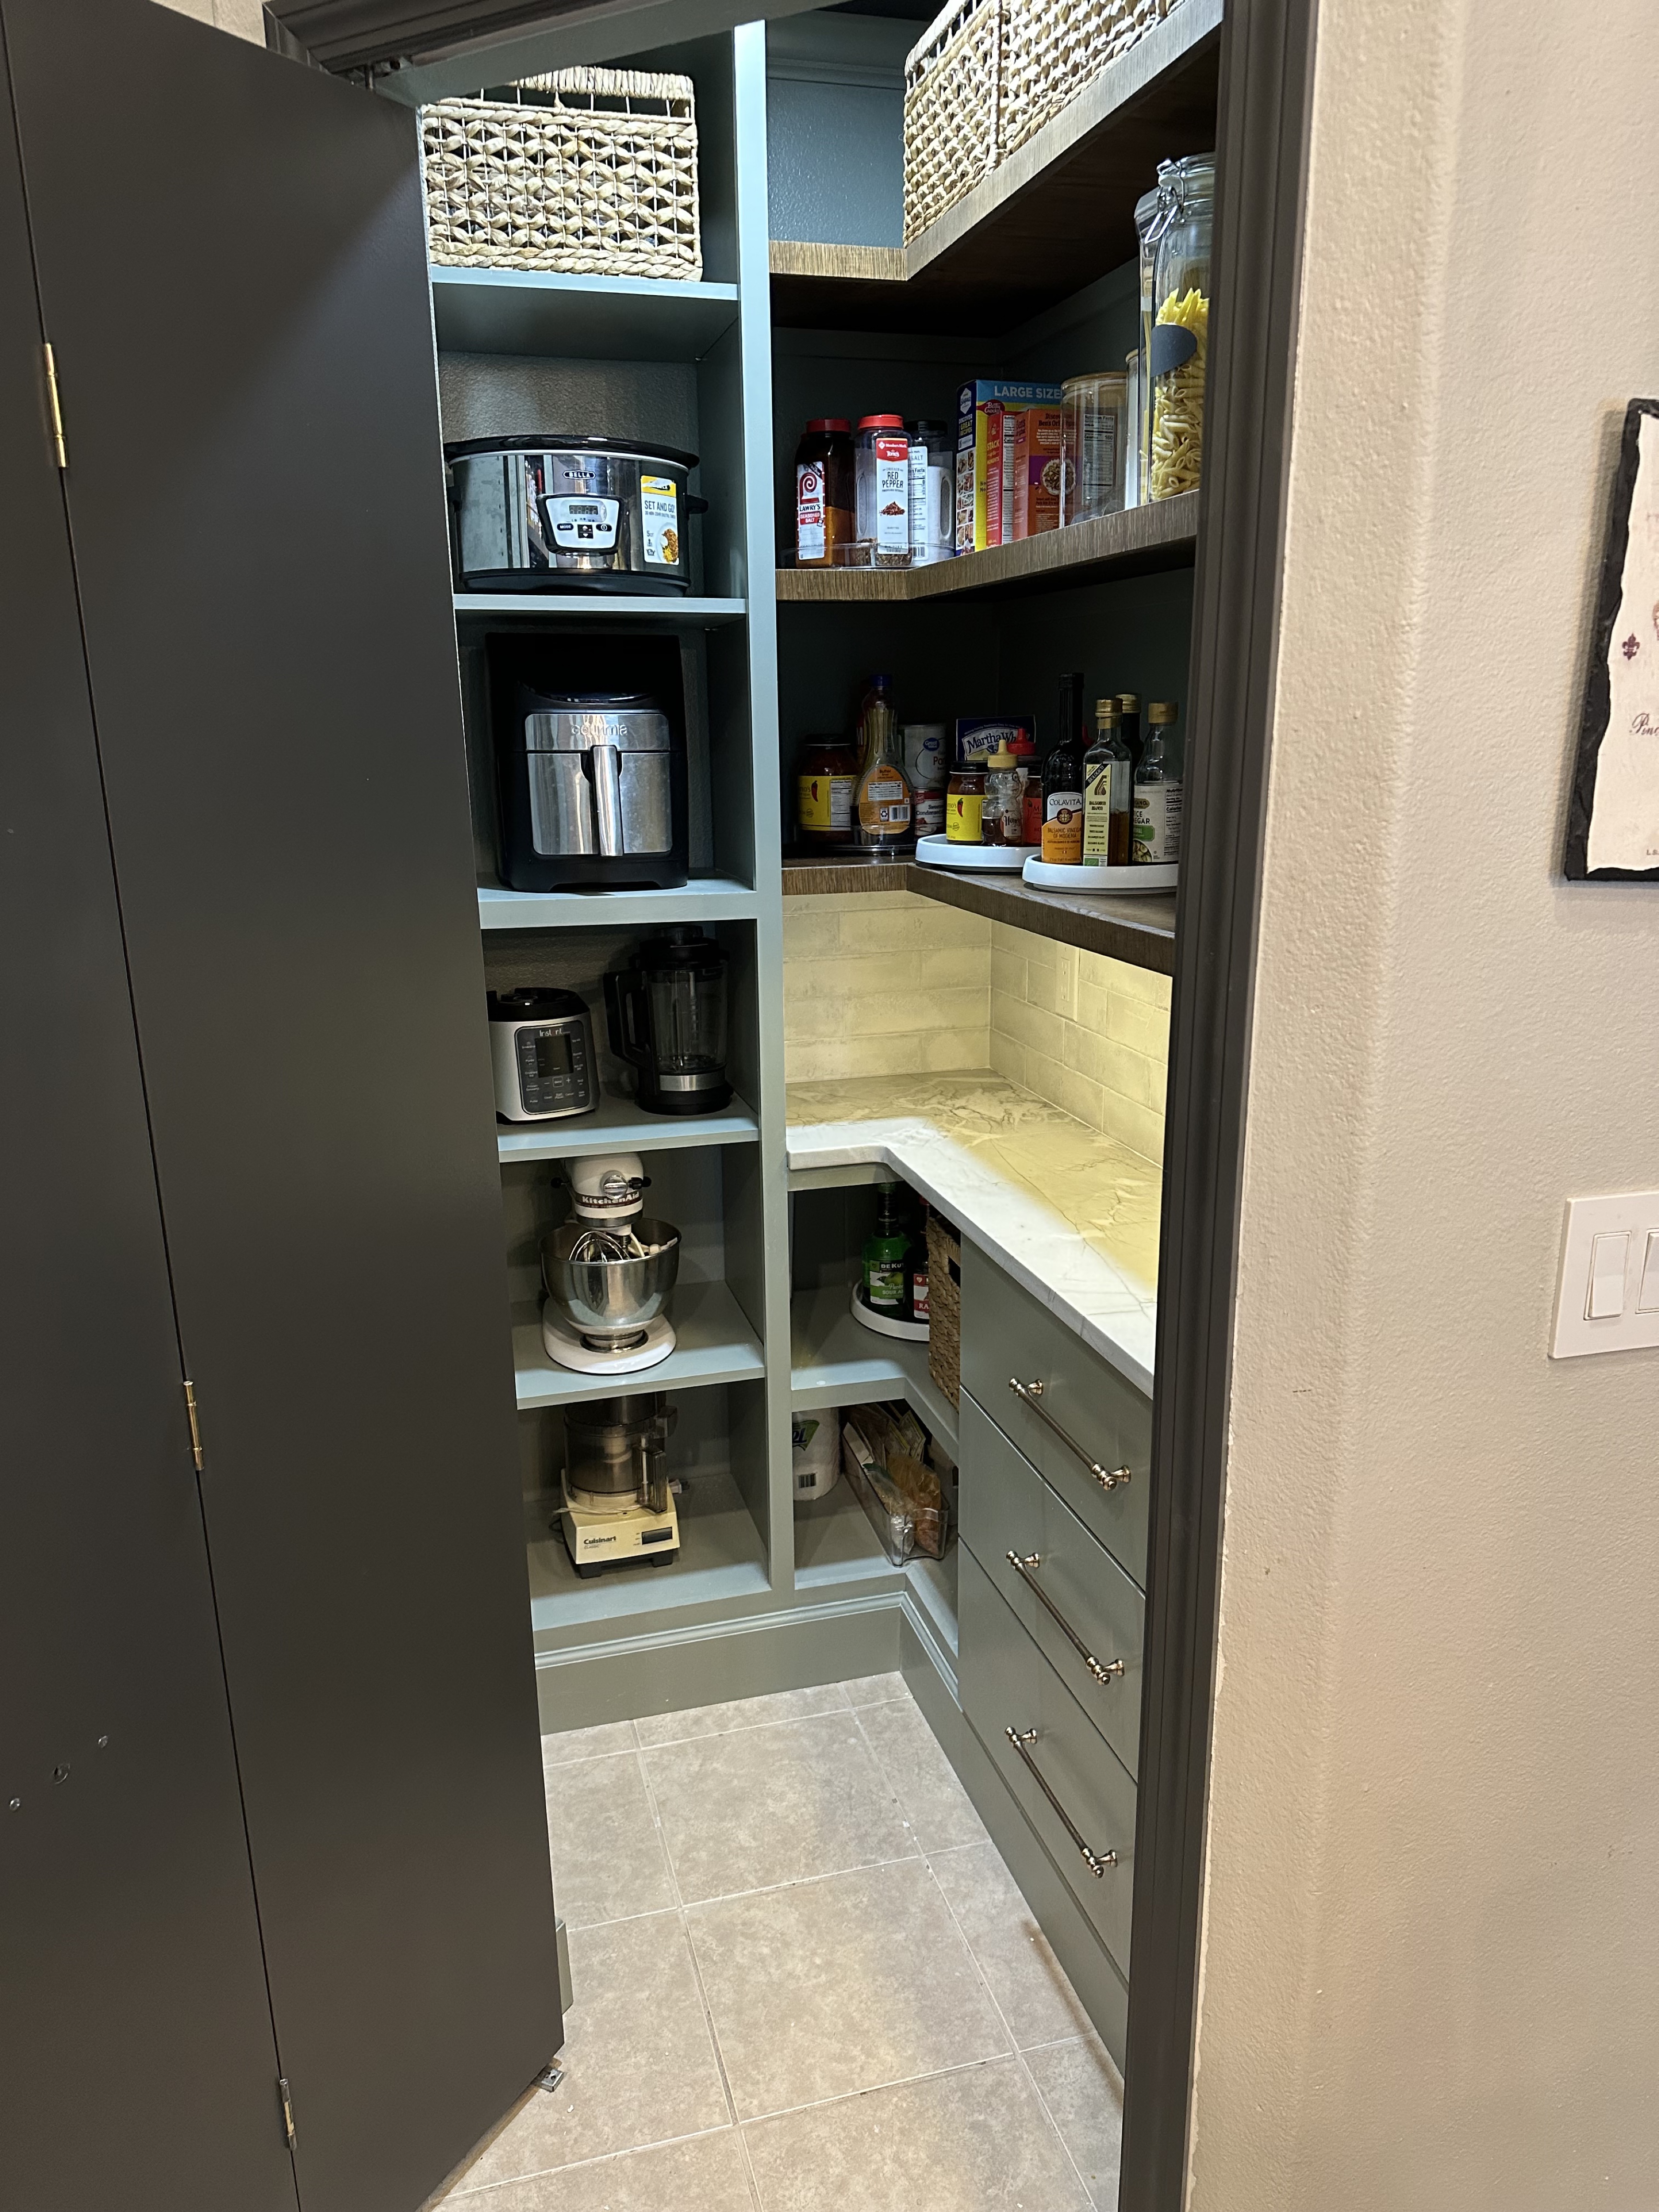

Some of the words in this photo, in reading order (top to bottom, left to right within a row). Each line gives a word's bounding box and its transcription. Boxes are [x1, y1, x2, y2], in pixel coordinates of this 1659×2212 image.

[994, 385, 1033, 398] LARGE
[1036, 388, 1060, 399] SIZE
[987, 439, 999, 450] STACK
[888, 471, 899, 480] RED
[882, 480, 903, 488] PEPPER
[645, 500, 655, 509] SET
[657, 502, 667, 512] AND
[966, 733, 1001, 754] Martha
[1000, 731, 1016, 744] Wh
[539, 1028, 563, 1036] Instant
[582, 1191, 639, 1204] KitchenAid
[584, 1536, 616, 1544] Cuisinart
